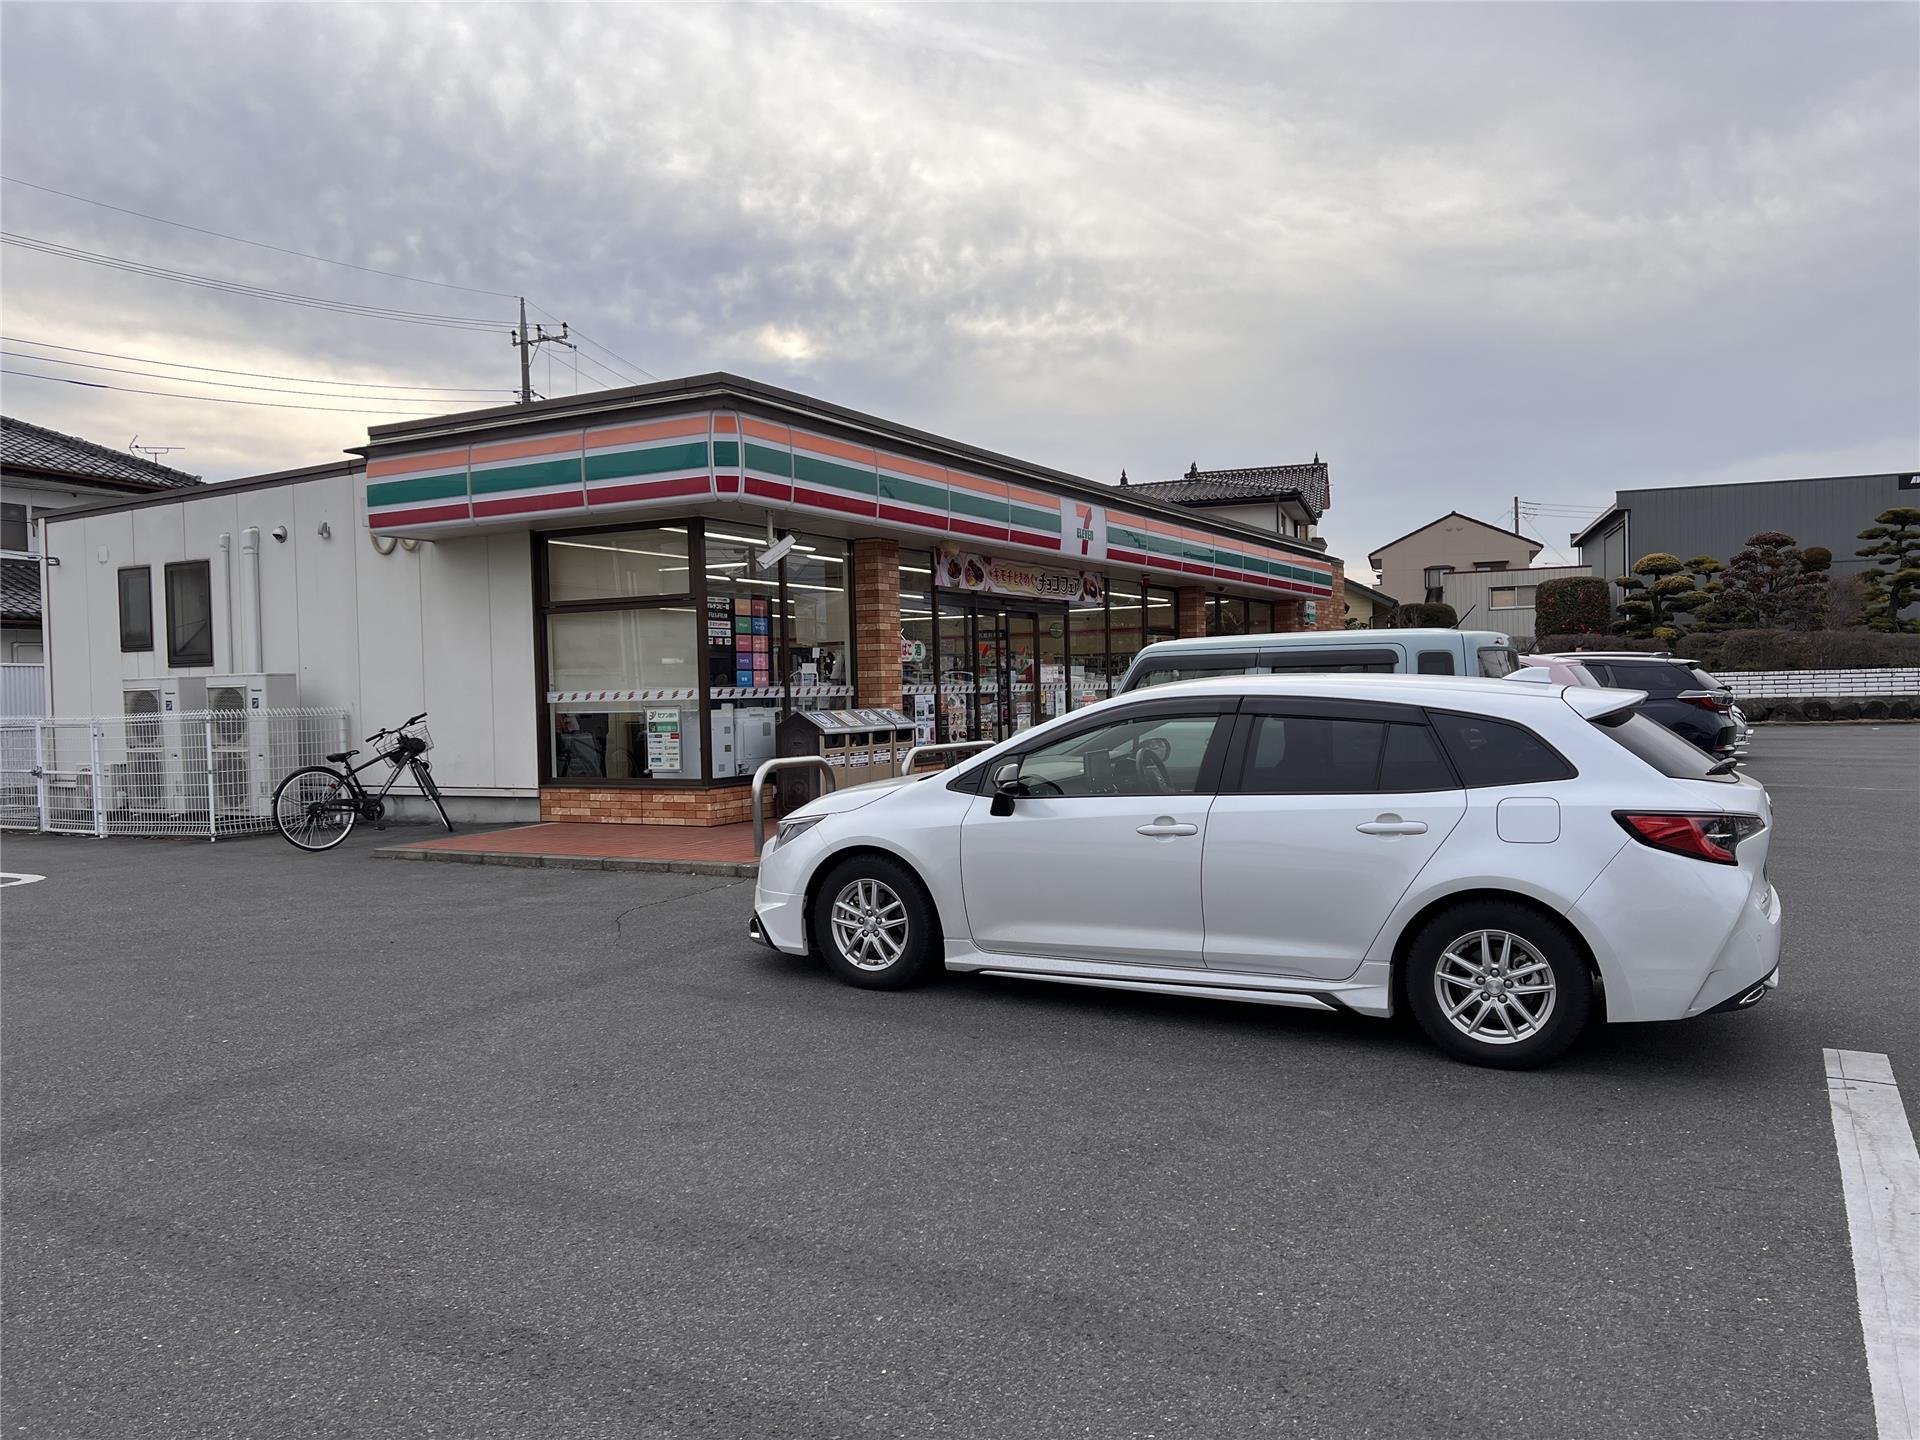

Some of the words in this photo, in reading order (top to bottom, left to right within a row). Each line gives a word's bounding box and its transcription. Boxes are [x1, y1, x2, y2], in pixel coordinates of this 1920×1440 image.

[1076, 503, 1093, 555] 7
[1076, 527, 1094, 542] ELEVEN
[1036, 572, 1080, 595] チョコフェア
[902, 643, 913, 656] ばこ
